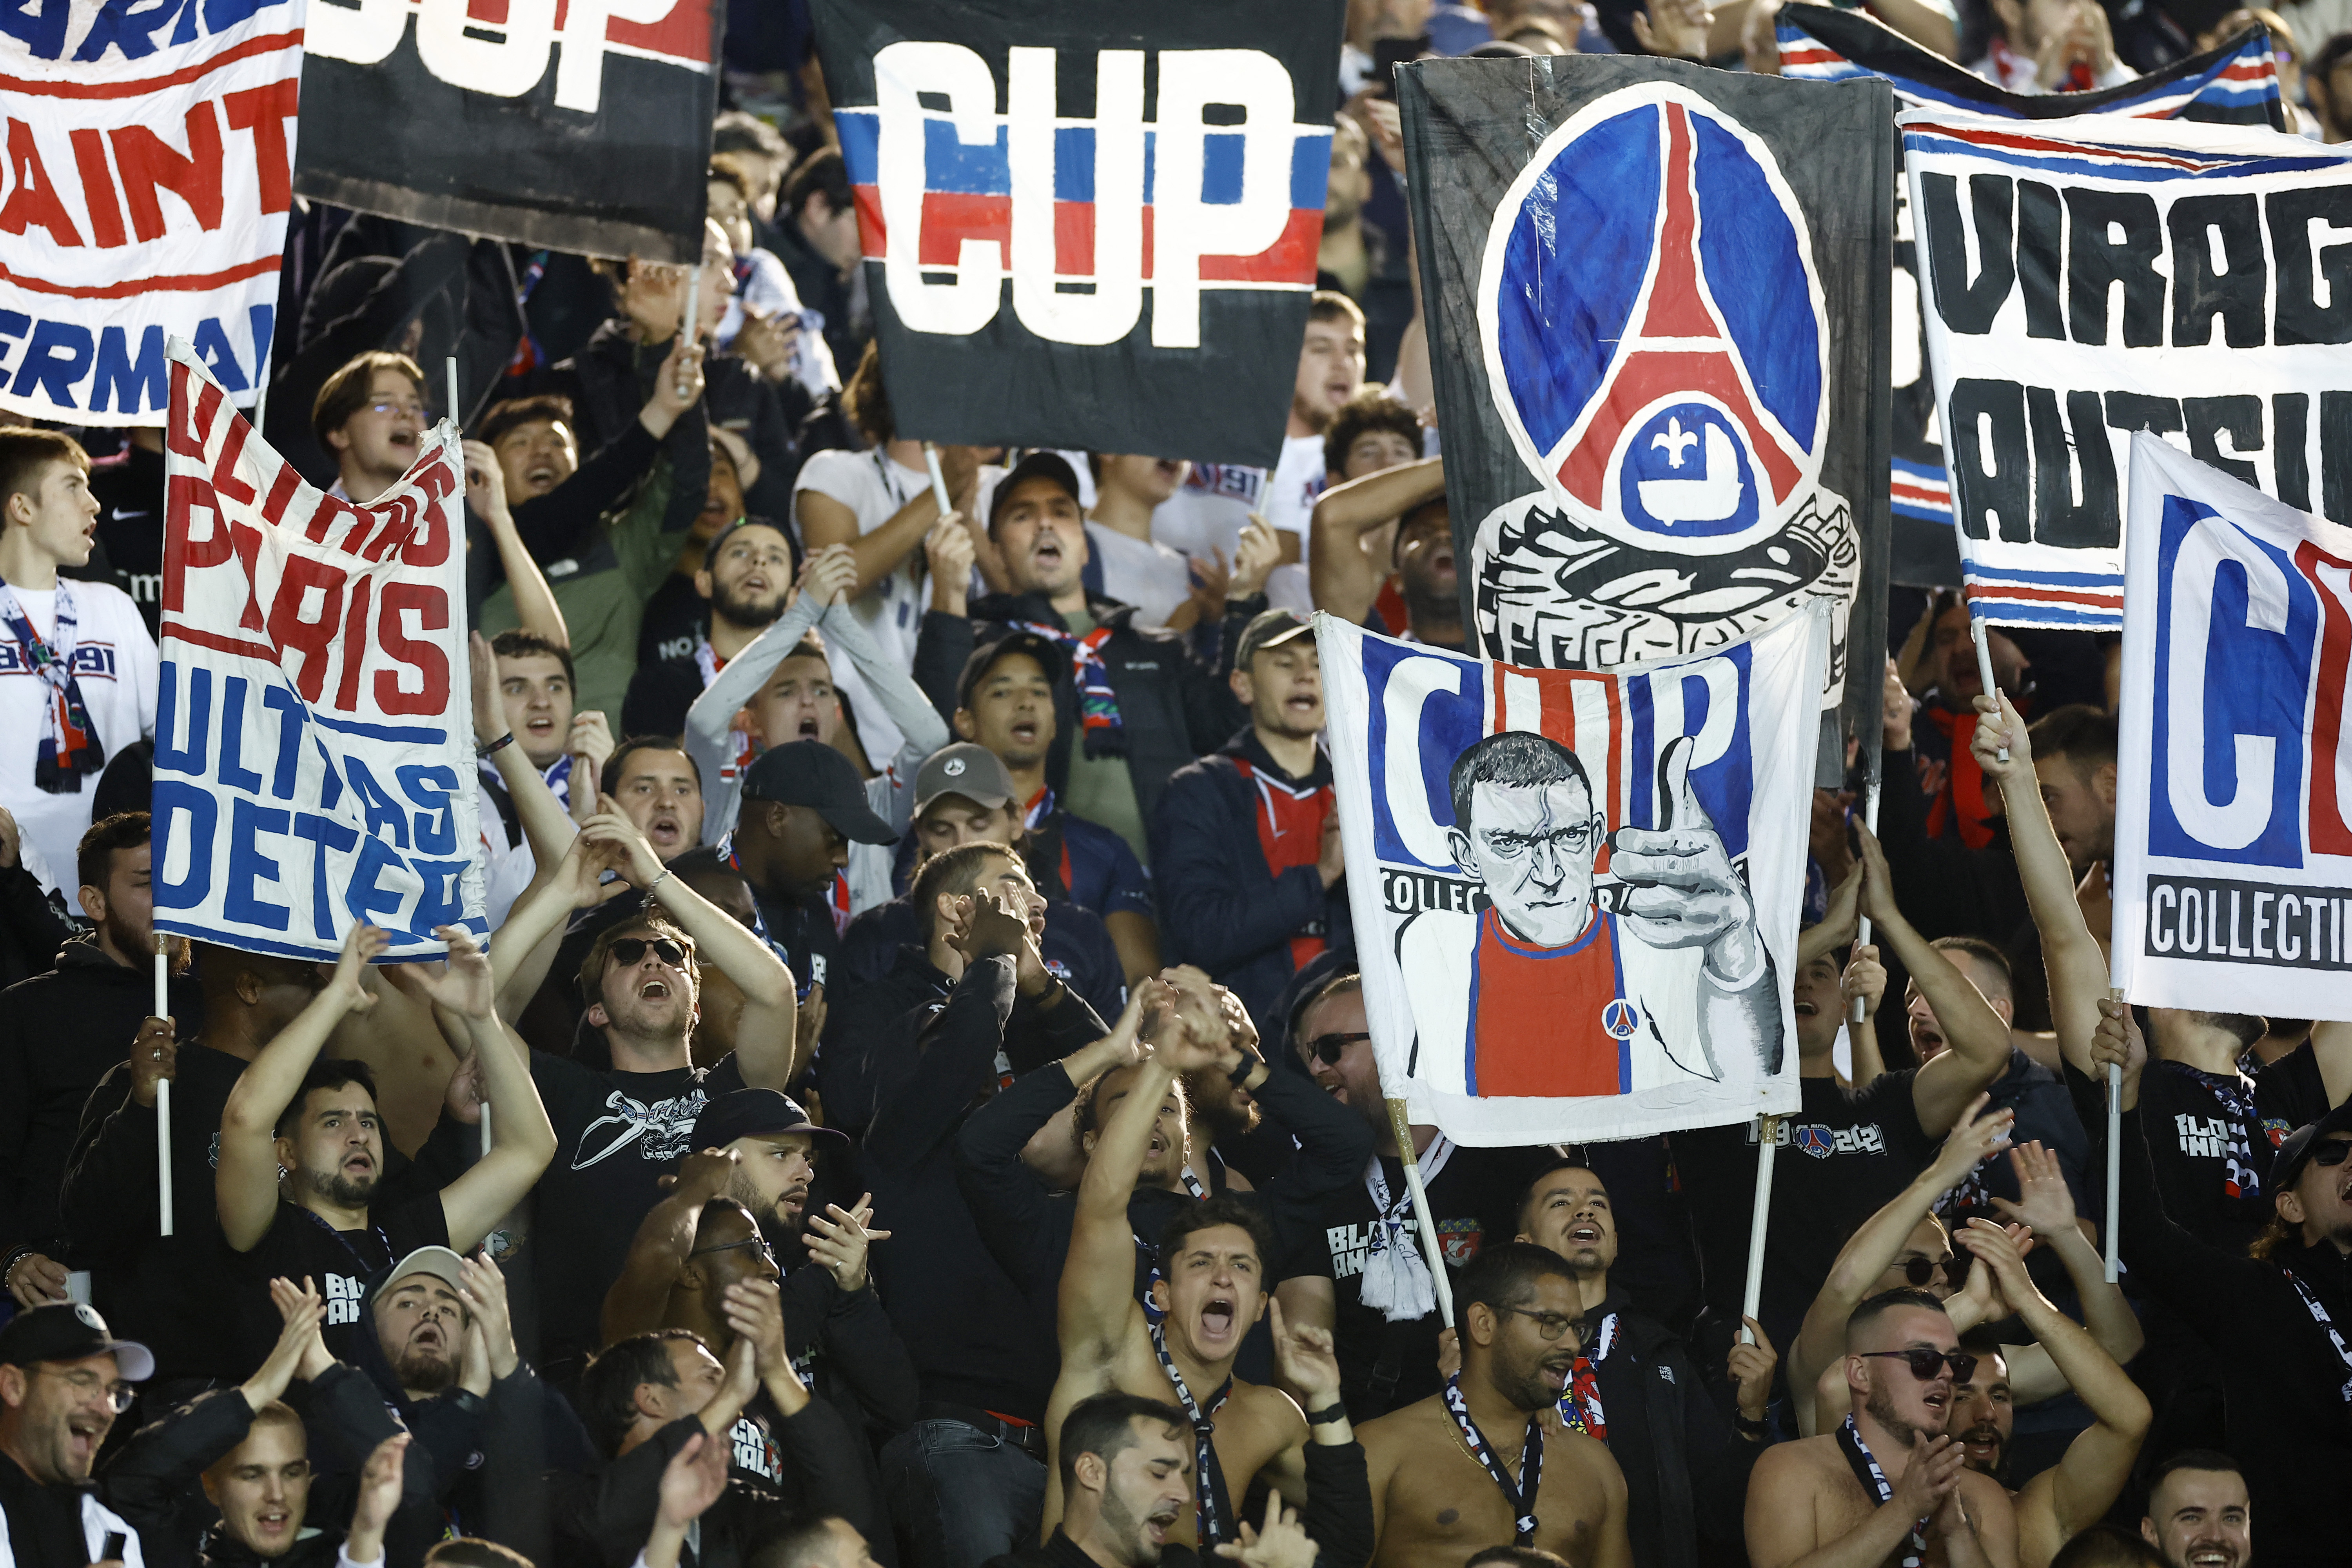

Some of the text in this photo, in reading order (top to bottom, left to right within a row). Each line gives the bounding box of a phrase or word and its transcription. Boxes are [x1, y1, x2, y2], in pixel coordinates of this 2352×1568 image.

[0, 78, 298, 248] AINT
[873, 40, 1295, 348] CUP
[1920, 172, 2352, 348] VIRAG
[2167, 516, 2352, 850] C
[1380, 871, 1490, 914] COLLEC
[2151, 884, 2352, 964] COLLECTI
